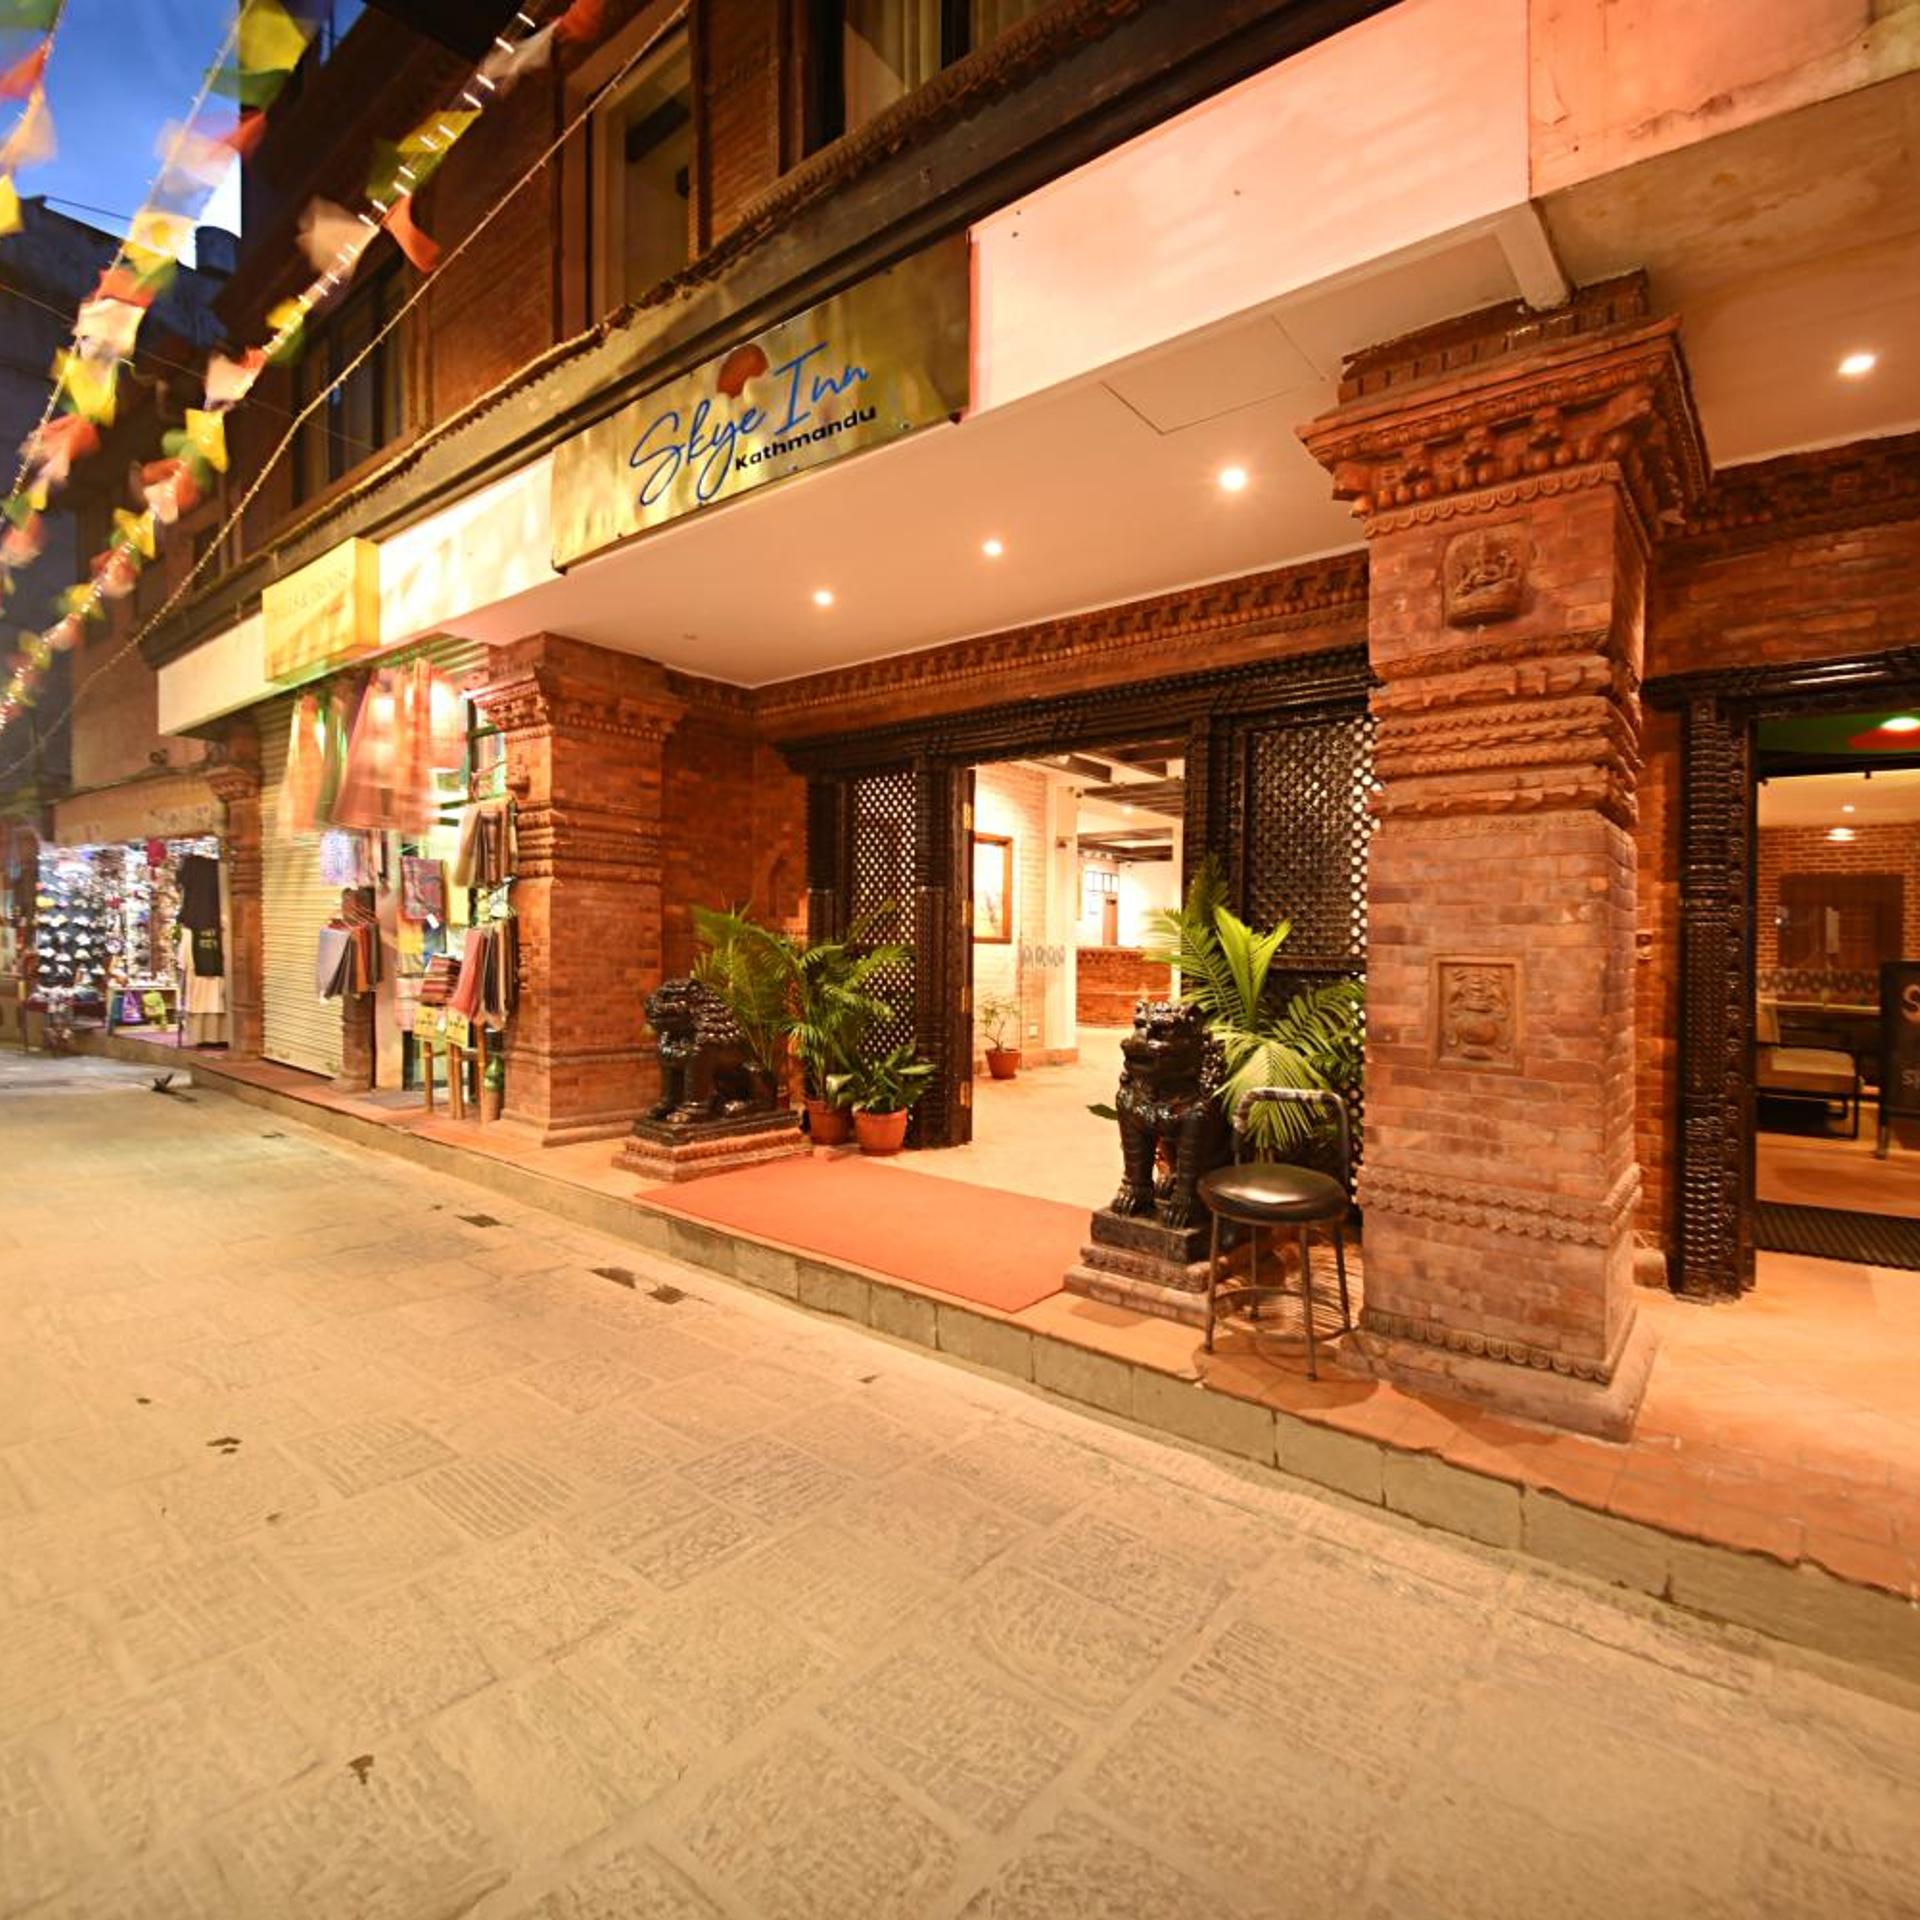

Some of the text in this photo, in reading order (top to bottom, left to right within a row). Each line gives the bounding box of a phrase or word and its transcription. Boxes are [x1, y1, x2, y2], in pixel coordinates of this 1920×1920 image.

[629, 341, 870, 507] Skye Inn
[734, 406, 877, 471] Kathmandu
